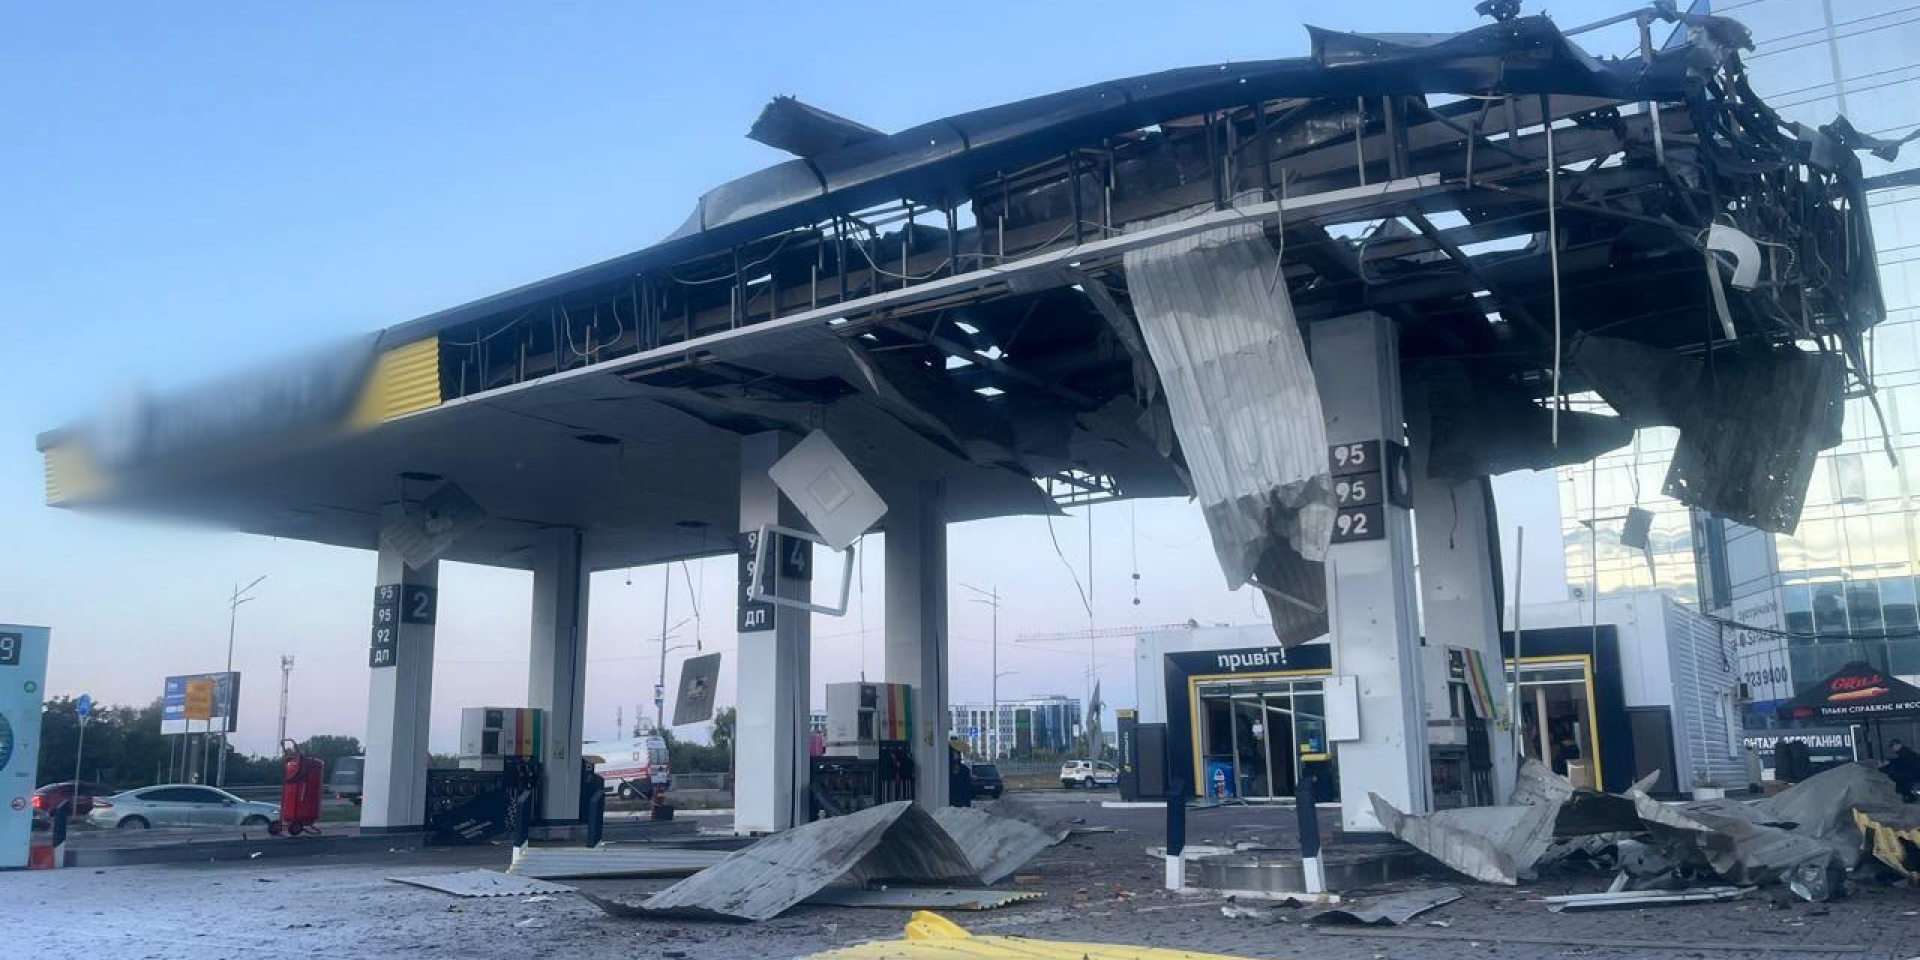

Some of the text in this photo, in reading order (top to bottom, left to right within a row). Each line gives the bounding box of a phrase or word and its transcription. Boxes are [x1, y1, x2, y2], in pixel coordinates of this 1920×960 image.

[1334, 443, 1366, 467] 95
[1335, 480, 1367, 504] 95
[1337, 512, 1368, 536] 92
[789, 539, 805, 572] 4
[380, 585, 394, 600] 95
[379, 608, 391, 622] 95
[413, 591, 430, 619] 2
[744, 608, 766, 628] ДП
[377, 629, 390, 643] 92
[374, 648, 390, 664] ДП
[1217, 647, 1288, 672] привіт!
